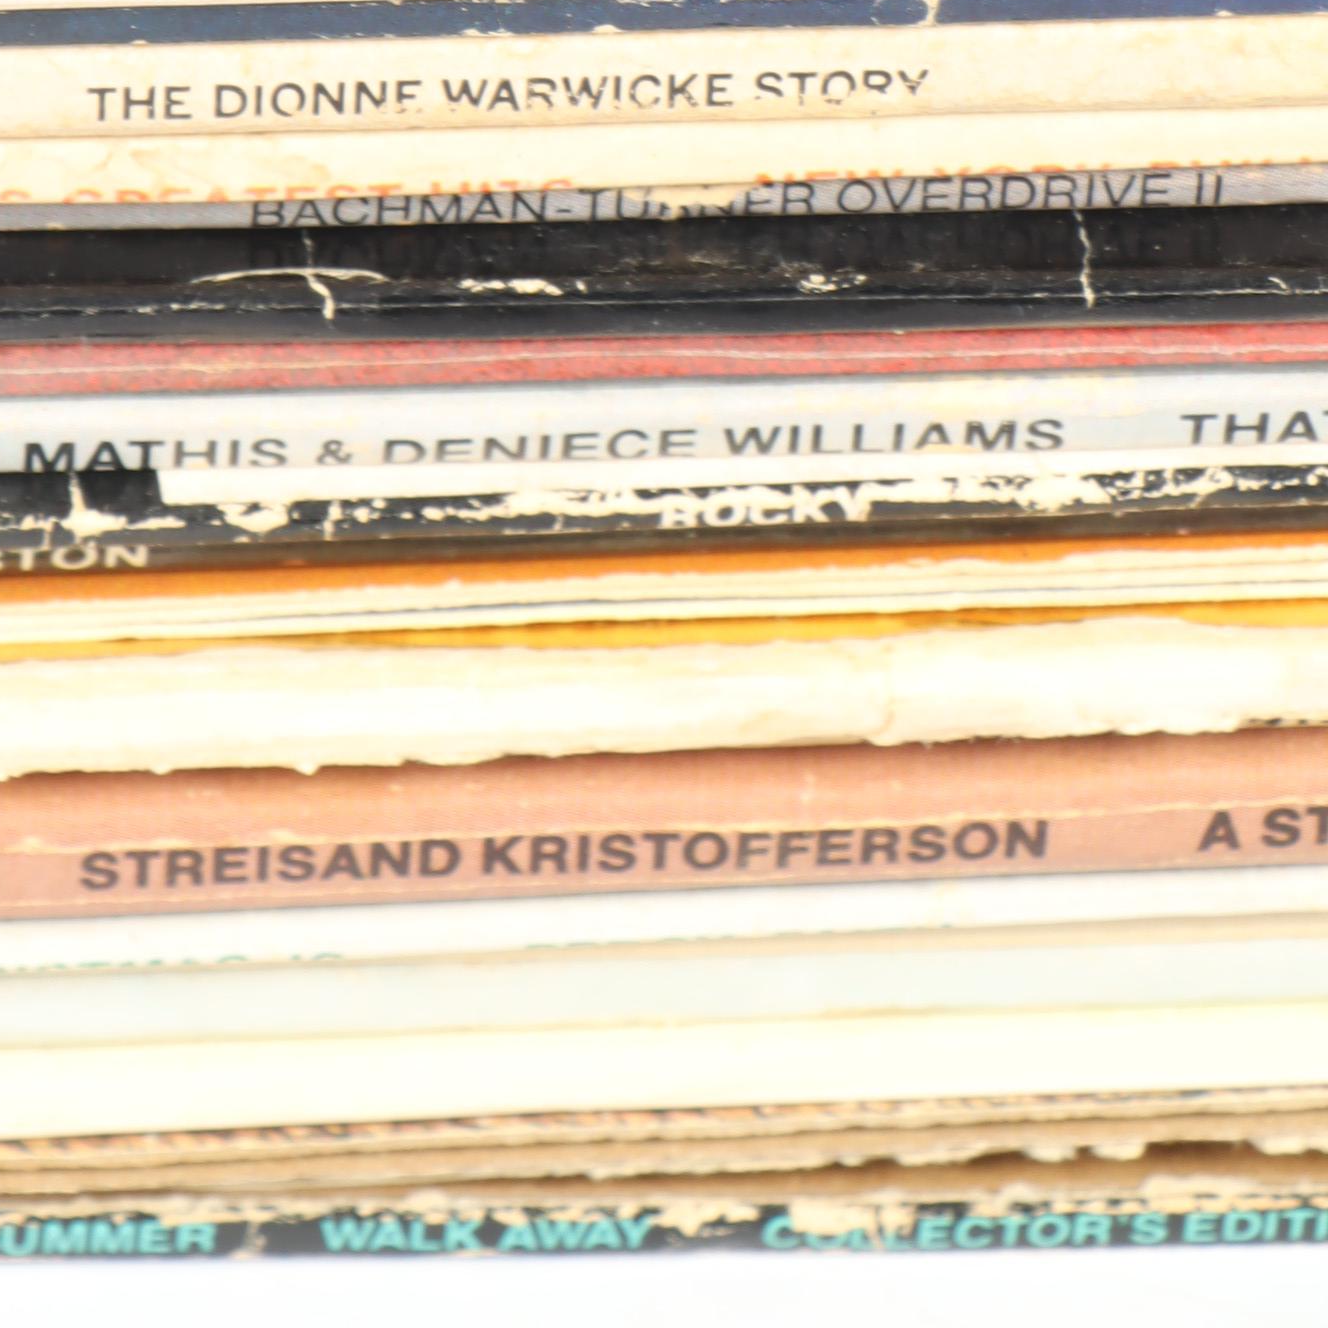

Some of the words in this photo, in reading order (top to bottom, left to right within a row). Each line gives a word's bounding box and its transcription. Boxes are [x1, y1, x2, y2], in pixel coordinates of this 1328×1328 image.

[88, 85, 192, 122] THE
[215, 76, 423, 120] DIONNE
[440, 71, 734, 115] WARWICKE
[755, 67, 931, 109] STORY
[835, 171, 1174, 214] OVERDRIVE
[23, 437, 289, 475] MATHIS
[314, 438, 355, 469] &
[381, 426, 699, 466] DENIECE
[723, 415, 1068, 459] WILLIAMS
[1179, 410, 1328, 446] THA
[658, 482, 870, 531] ROCKY
[79, 837, 463, 893] STREISAND
[480, 819, 1052, 877] KRISTOFFERSON
[1196, 810, 1243, 854] A
[319, 1216, 489, 1253] WALK
[497, 1215, 654, 1251] AWAY
